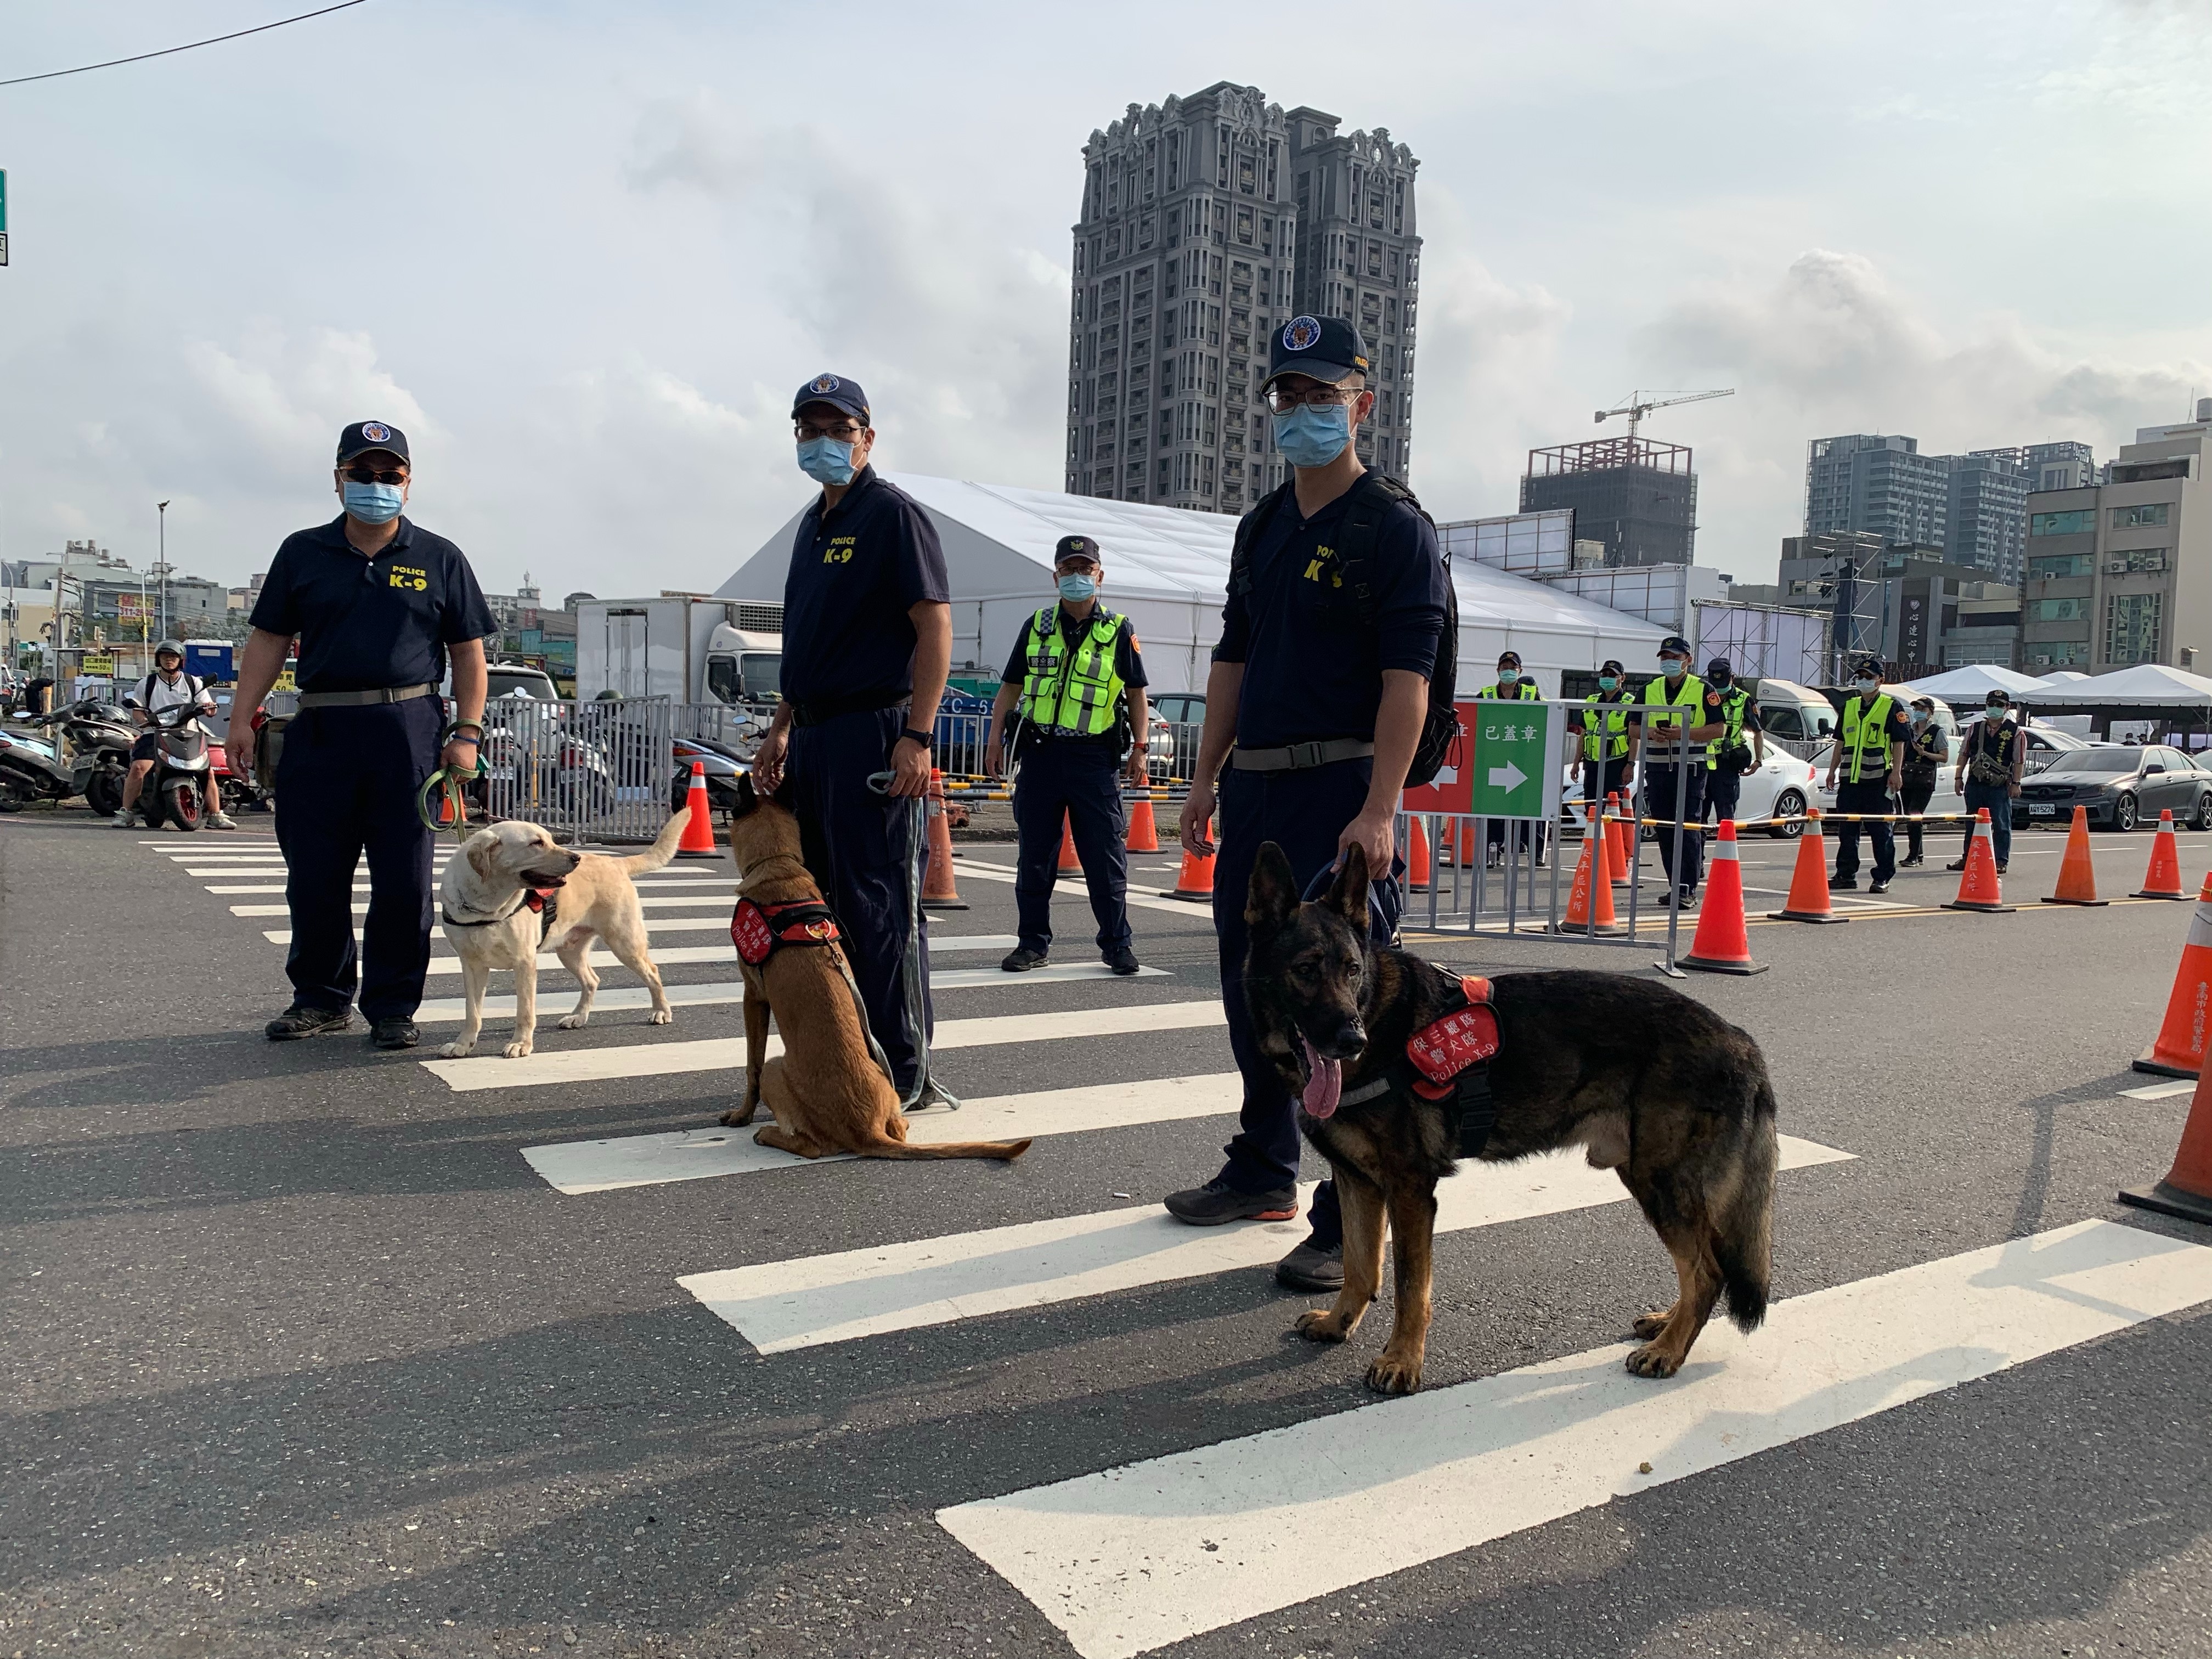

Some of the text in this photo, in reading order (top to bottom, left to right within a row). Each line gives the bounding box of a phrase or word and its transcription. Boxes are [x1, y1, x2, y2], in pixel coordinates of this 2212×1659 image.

[831, 537, 856, 545] POLICE
[823, 548, 853, 563] K-9
[392, 565, 426, 577] POLICE
[390, 574, 427, 591] K-9
[1485, 724, 1537, 743] 已蓋章
[1573, 848, 1592, 912] 安平區公所
[732, 925, 747, 950] Police
[1413, 1012, 1476, 1053] 保三總隊
[1430, 1031, 1478, 1065] 警犬隊
[1430, 1043, 1495, 1081] Police K-9
